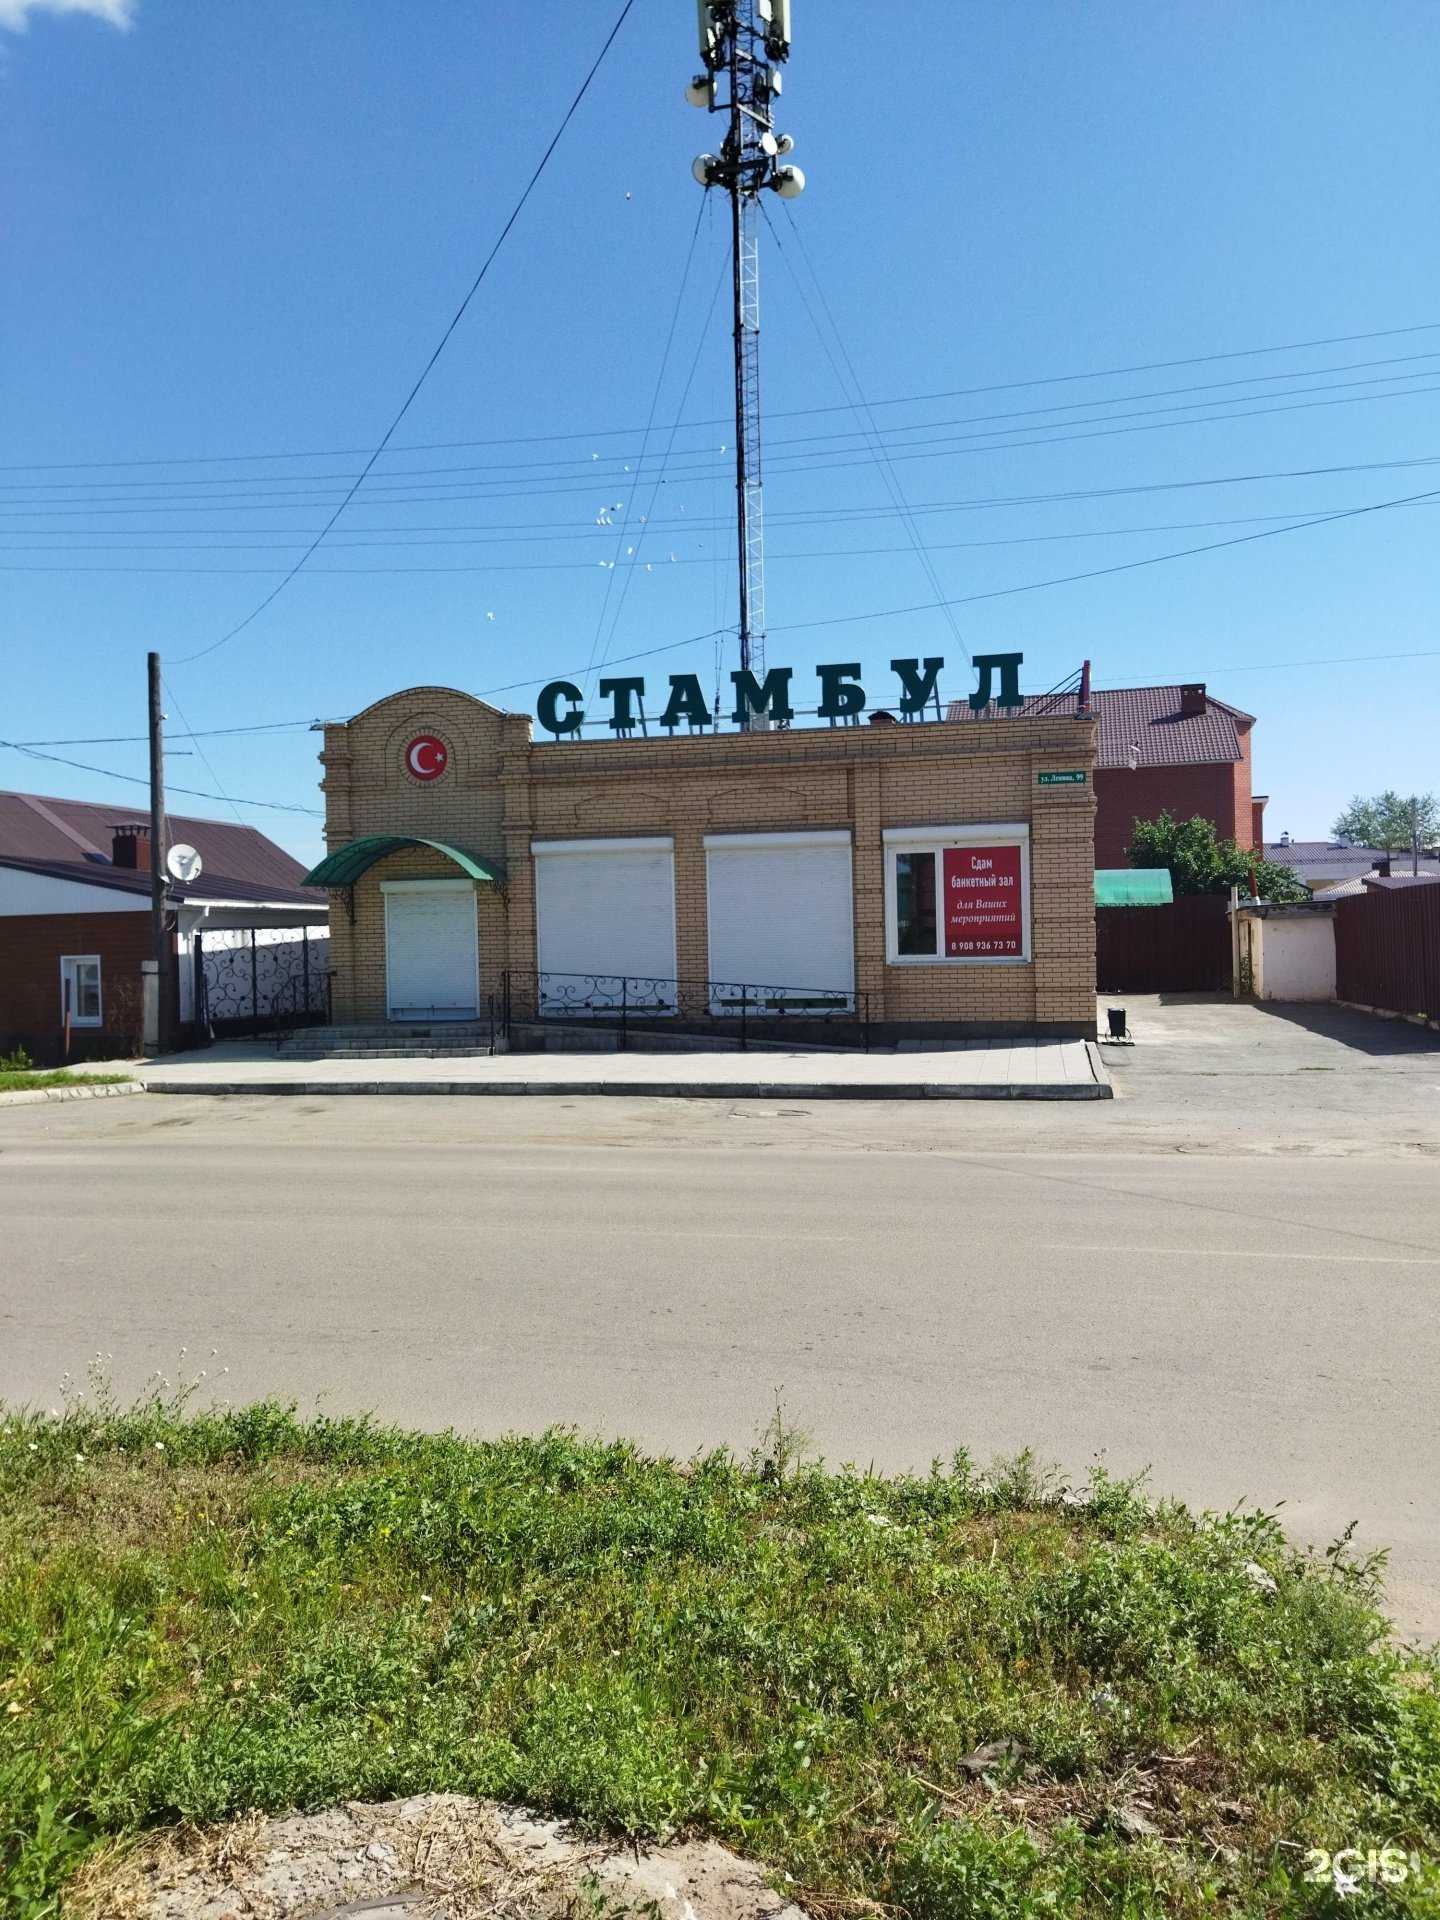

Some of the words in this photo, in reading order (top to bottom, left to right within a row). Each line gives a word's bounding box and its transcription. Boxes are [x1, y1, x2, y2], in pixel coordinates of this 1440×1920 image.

[536, 652, 1025, 734] СТАМБУЛ
[1041, 776, 1049, 784] ул.
[1076, 773, 1084, 781] 99
[971, 856, 993, 870] Сдам
[951, 874, 997, 888] банкетный
[999, 876, 1014, 887] зал
[956, 900, 973, 910] для
[976, 899, 1008, 909] Ваших
[951, 912, 1016, 925] мероприятий
[951, 942, 956, 950] 8
[959, 941, 974, 950] 908
[976, 941, 991, 950] 936
[993, 941, 1003, 950] 73
[1006, 940, 1016, 949] 70
